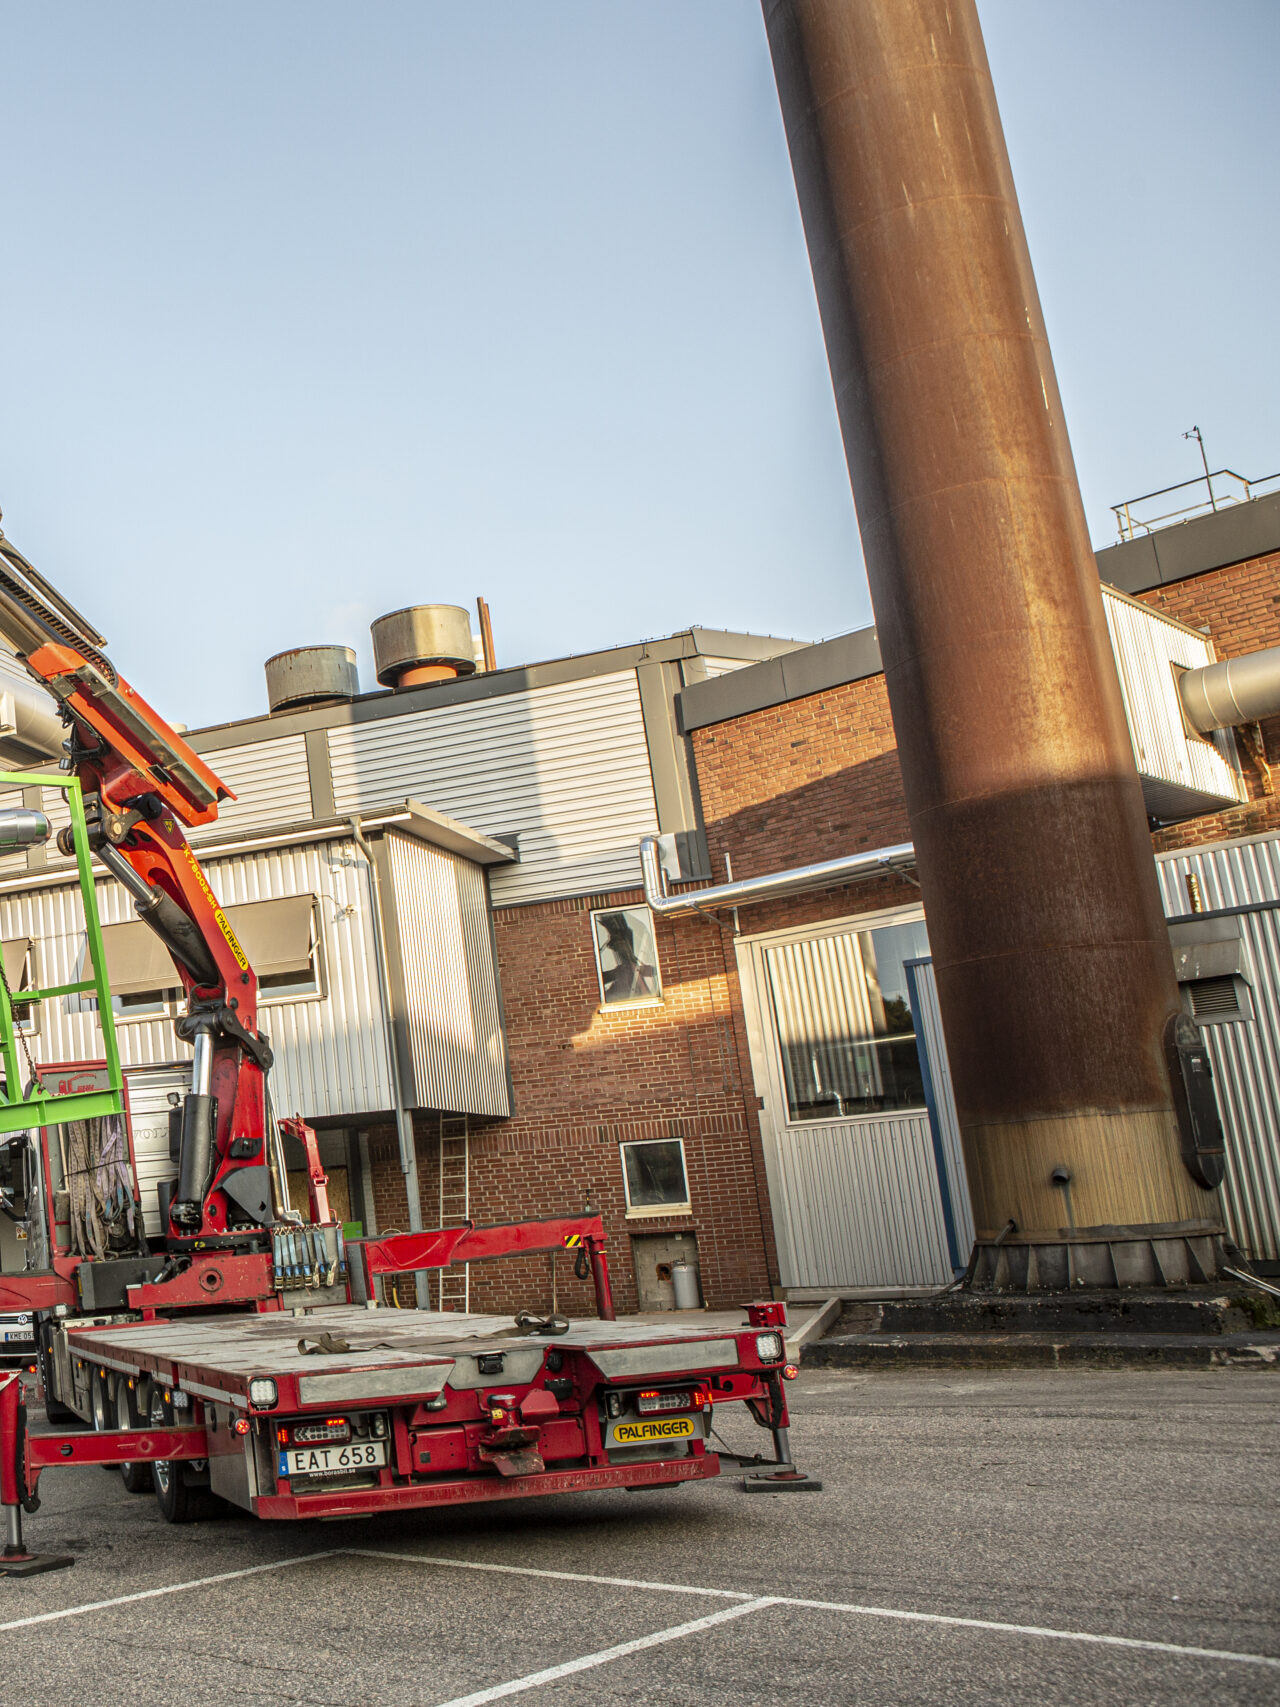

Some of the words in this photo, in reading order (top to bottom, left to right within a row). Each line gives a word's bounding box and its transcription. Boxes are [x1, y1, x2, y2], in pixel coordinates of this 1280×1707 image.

[216, 912, 246, 967] PALFINGER
[619, 1421, 689, 1440] PALFINGER
[294, 1449, 332, 1471] EAT
[338, 1445, 376, 1466] 658
